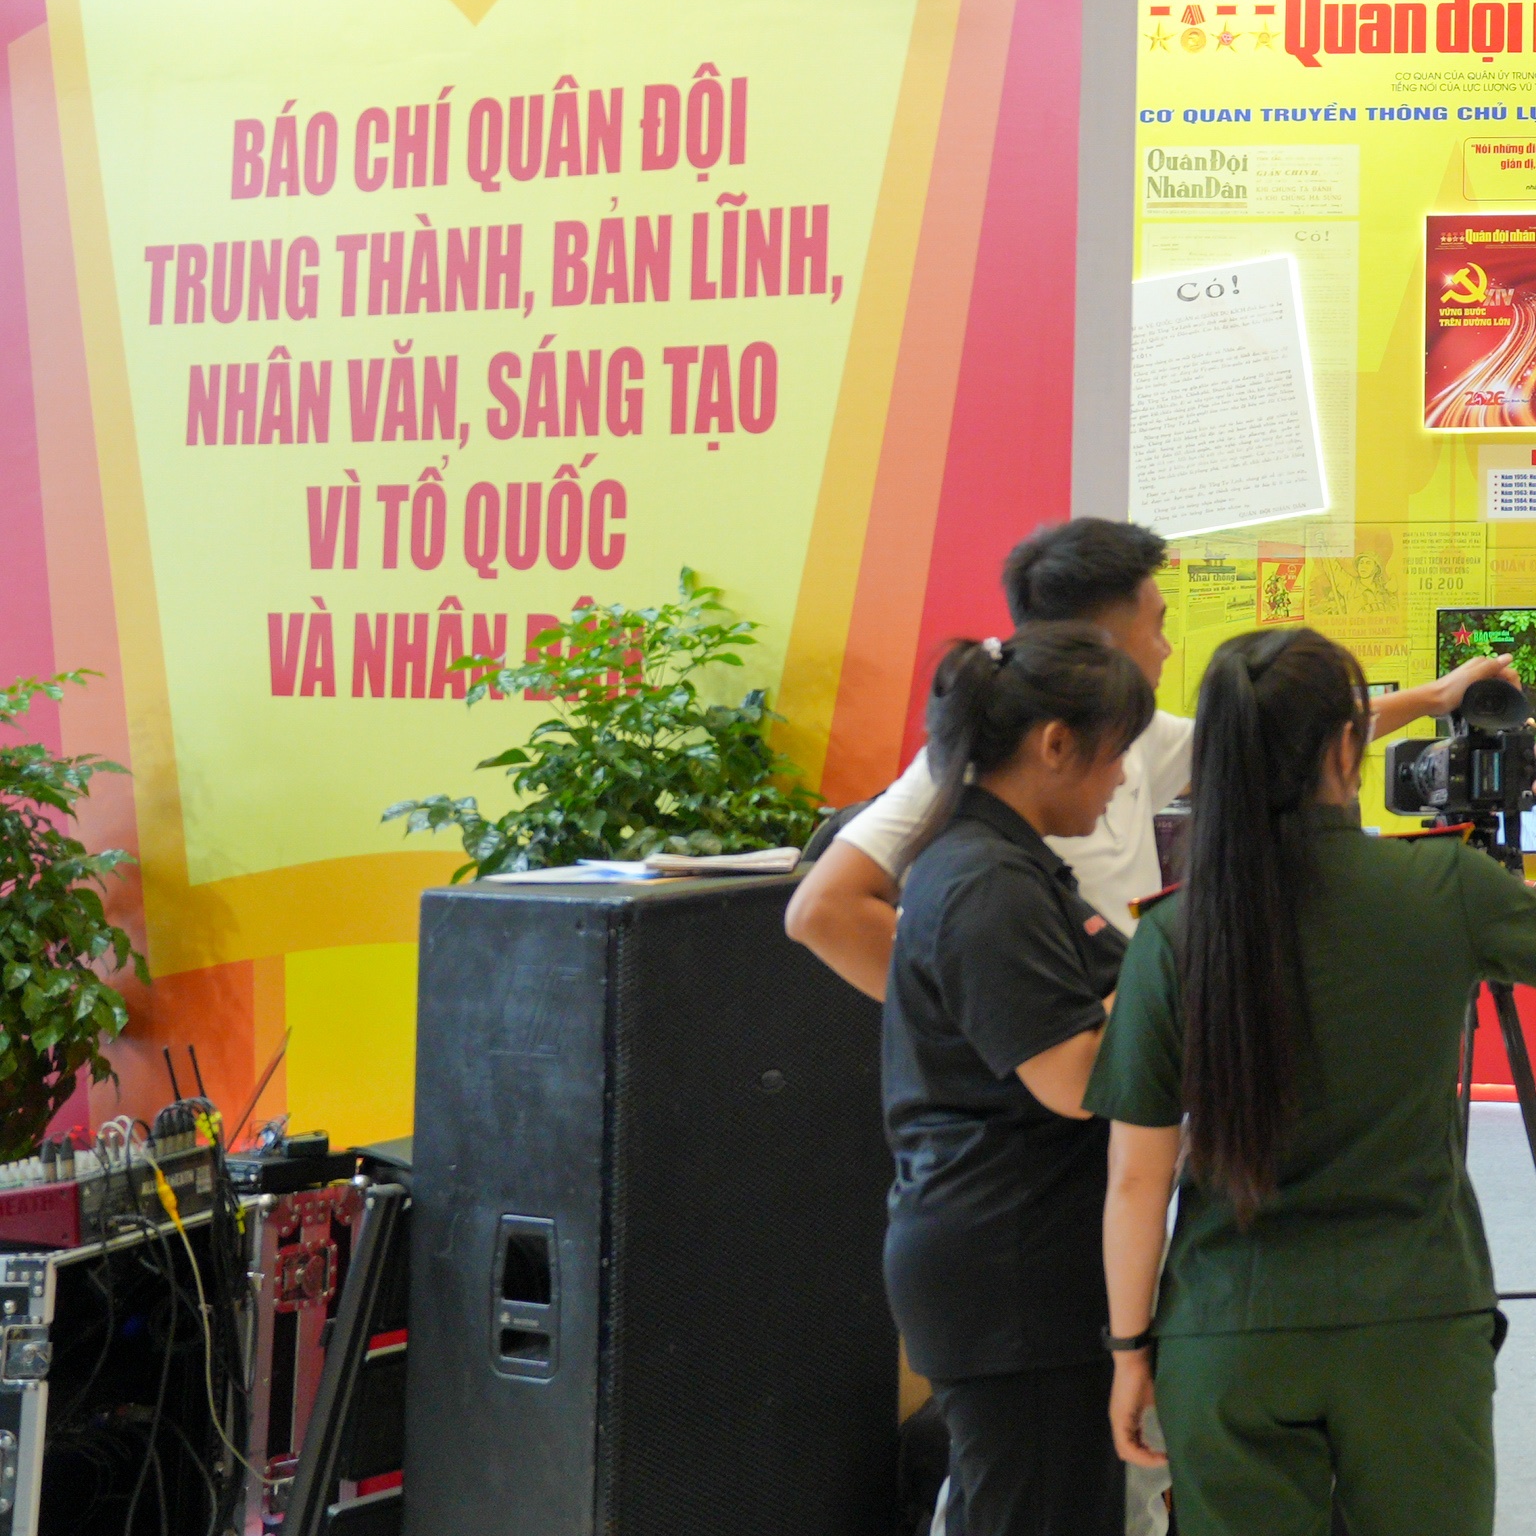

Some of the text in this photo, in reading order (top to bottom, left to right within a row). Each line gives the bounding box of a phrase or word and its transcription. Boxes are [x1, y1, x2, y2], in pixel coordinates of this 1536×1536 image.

[231, 63, 748, 200] BÁO CHÍ QUÂN ĐỘI
[1139, 109, 1174, 123] CƠ
[1183, 108, 1251, 124] QUAN
[1260, 102, 1356, 121] TRUYỀN
[1365, 104, 1448, 120] THÔNG
[1457, 102, 1507, 120] CHỦ
[145, 192, 844, 326] TRUNG THÀNH, BẢN LĨNH,
[1176, 275, 1240, 302] Có!
[186, 335, 779, 452] NHÂN VĂN, SÁNG TẠO
[307, 453, 627, 580] VÌ TỔ QUỐC
[267, 597, 335, 698] VÀ
[352, 596, 507, 700] NHÂN
